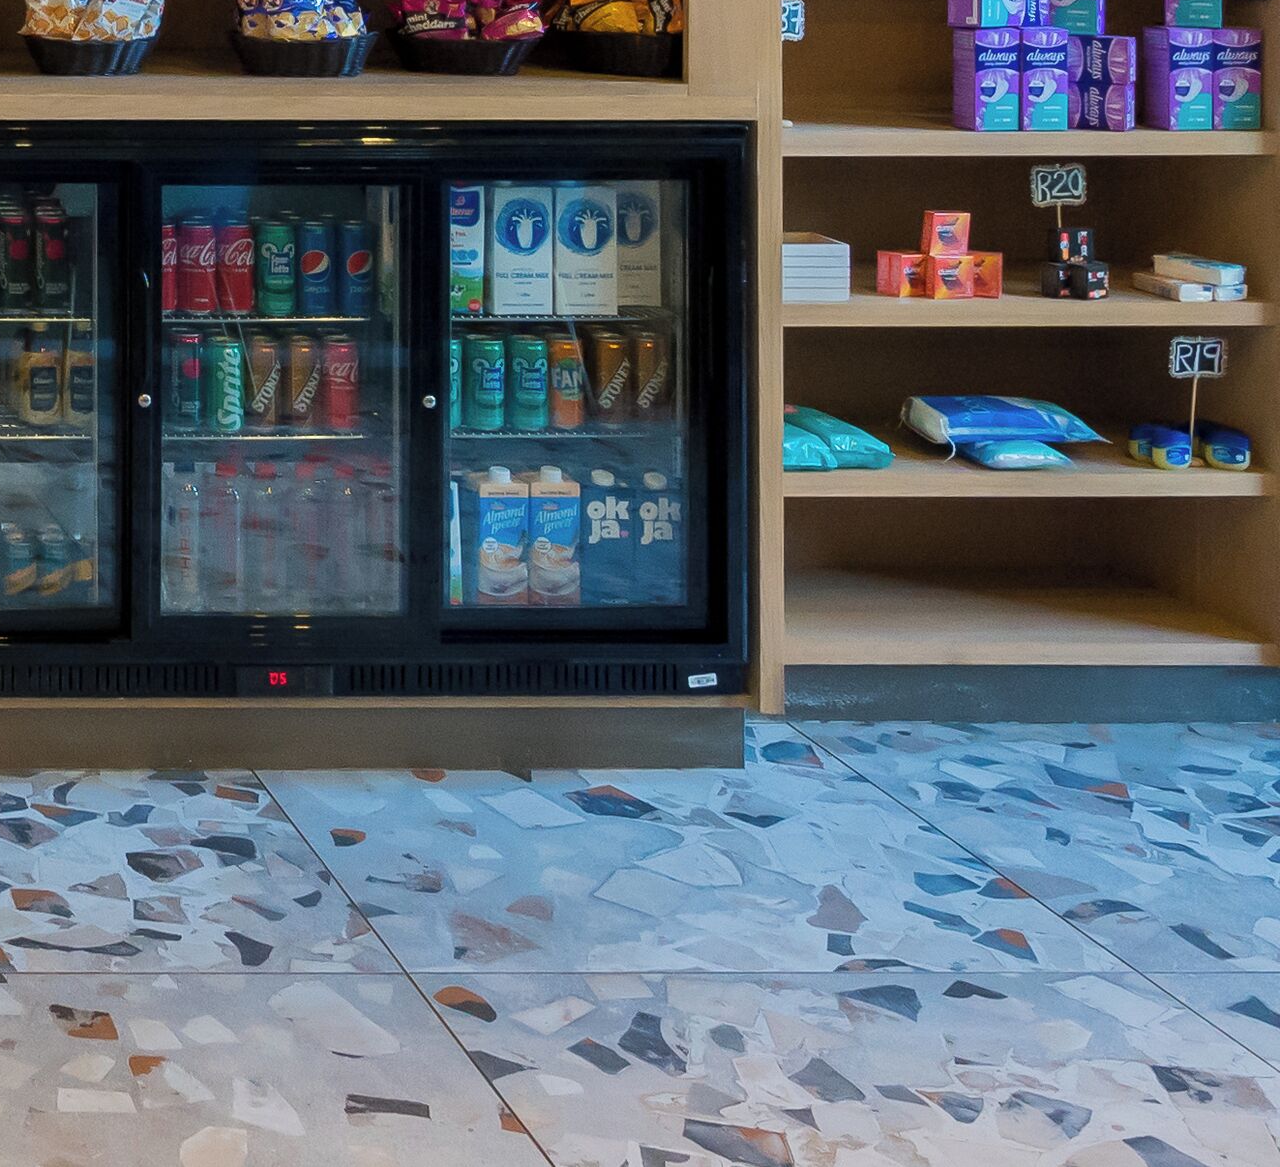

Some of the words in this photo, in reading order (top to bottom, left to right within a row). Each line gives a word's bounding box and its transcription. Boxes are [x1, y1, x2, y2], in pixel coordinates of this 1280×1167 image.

[406, 14, 427, 24] mini
[978, 48, 1018, 64] always
[1026, 48, 1066, 64] always
[1092, 39, 1102, 79] always
[1172, 48, 1211, 64] always
[1217, 48, 1259, 64] always
[1089, 86, 1100, 127] always
[1037, 172, 1082, 201] R20
[1177, 343, 1222, 373] R19
[218, 348, 243, 430] Sprite
[251, 360, 281, 412] STONEY
[293, 365, 321, 412] STONEY
[551, 367, 583, 390] FAN
[598, 358, 631, 409] STONEY
[637, 361, 668, 409] STONEY
[483, 504, 526, 526] Almond
[534, 504, 578, 526] Almond
[587, 496, 630, 520] ok
[640, 497, 681, 521] ok
[641, 521, 673, 545] ja
